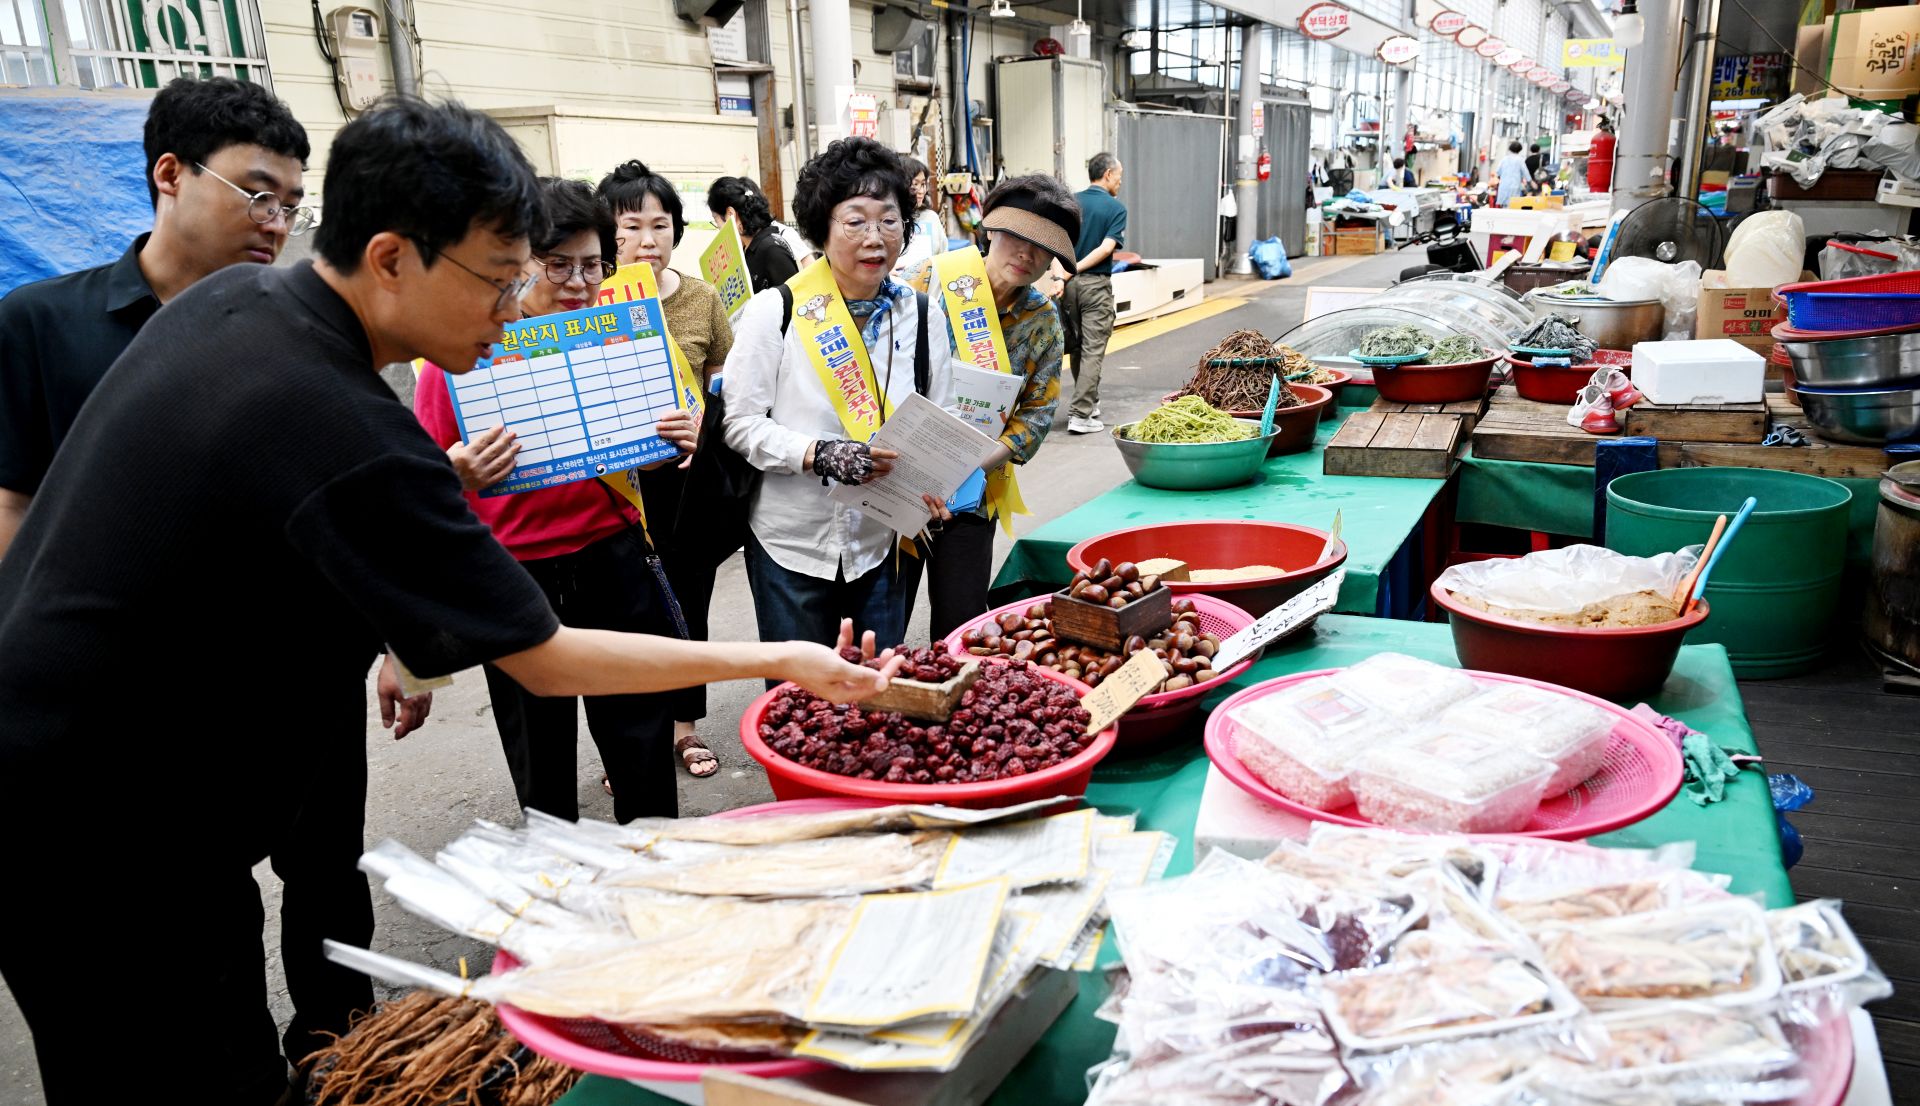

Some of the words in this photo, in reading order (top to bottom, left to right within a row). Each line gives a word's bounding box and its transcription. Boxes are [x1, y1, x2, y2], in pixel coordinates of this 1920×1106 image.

[1308, 14, 1348, 27] 부덕상회
[500, 323, 559, 351] 원산지
[564, 313, 618, 338] 표시판
[594, 437, 611, 446] 상호명
[555, 457, 585, 471] 스캔하면
[586, 452, 608, 466] 원산지
